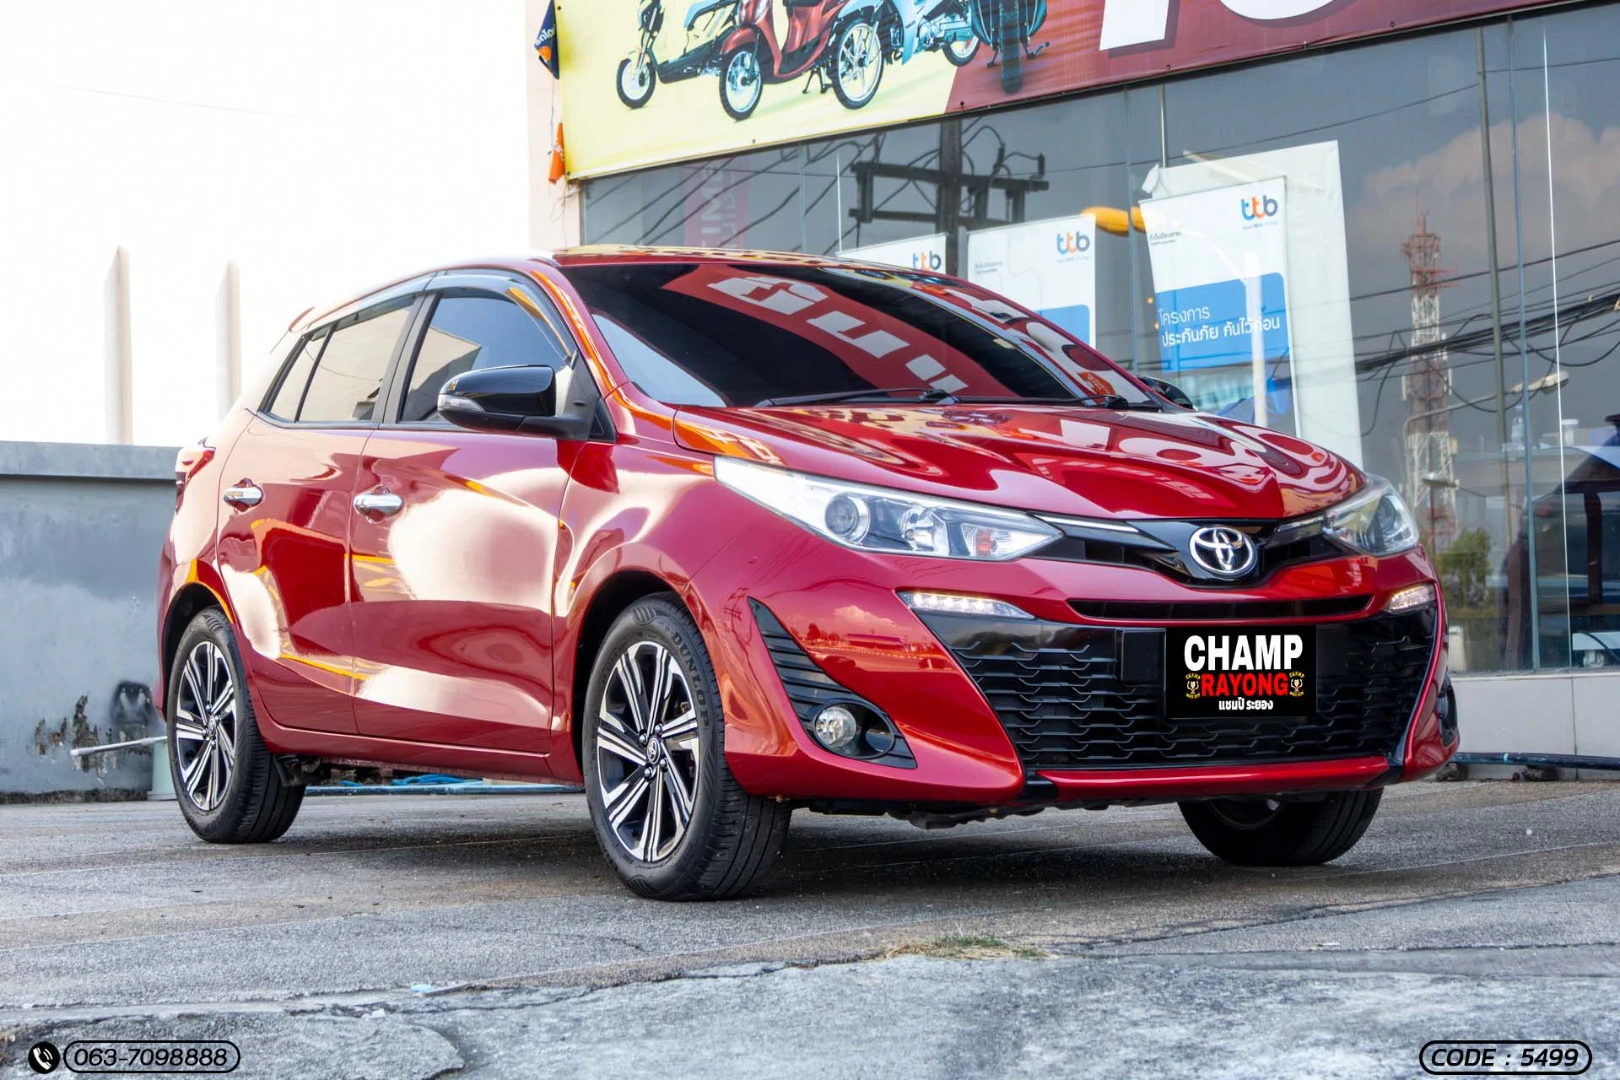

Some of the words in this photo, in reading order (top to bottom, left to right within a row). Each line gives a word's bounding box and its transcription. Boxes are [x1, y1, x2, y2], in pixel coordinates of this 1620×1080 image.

[1240, 195, 1279, 221] ttb
[1056, 231, 1091, 255] ttb
[1158, 306, 1211, 326] โครงการ
[1161, 324, 1220, 347] ประกันภัย
[671, 631, 710, 727] DUNLOP
